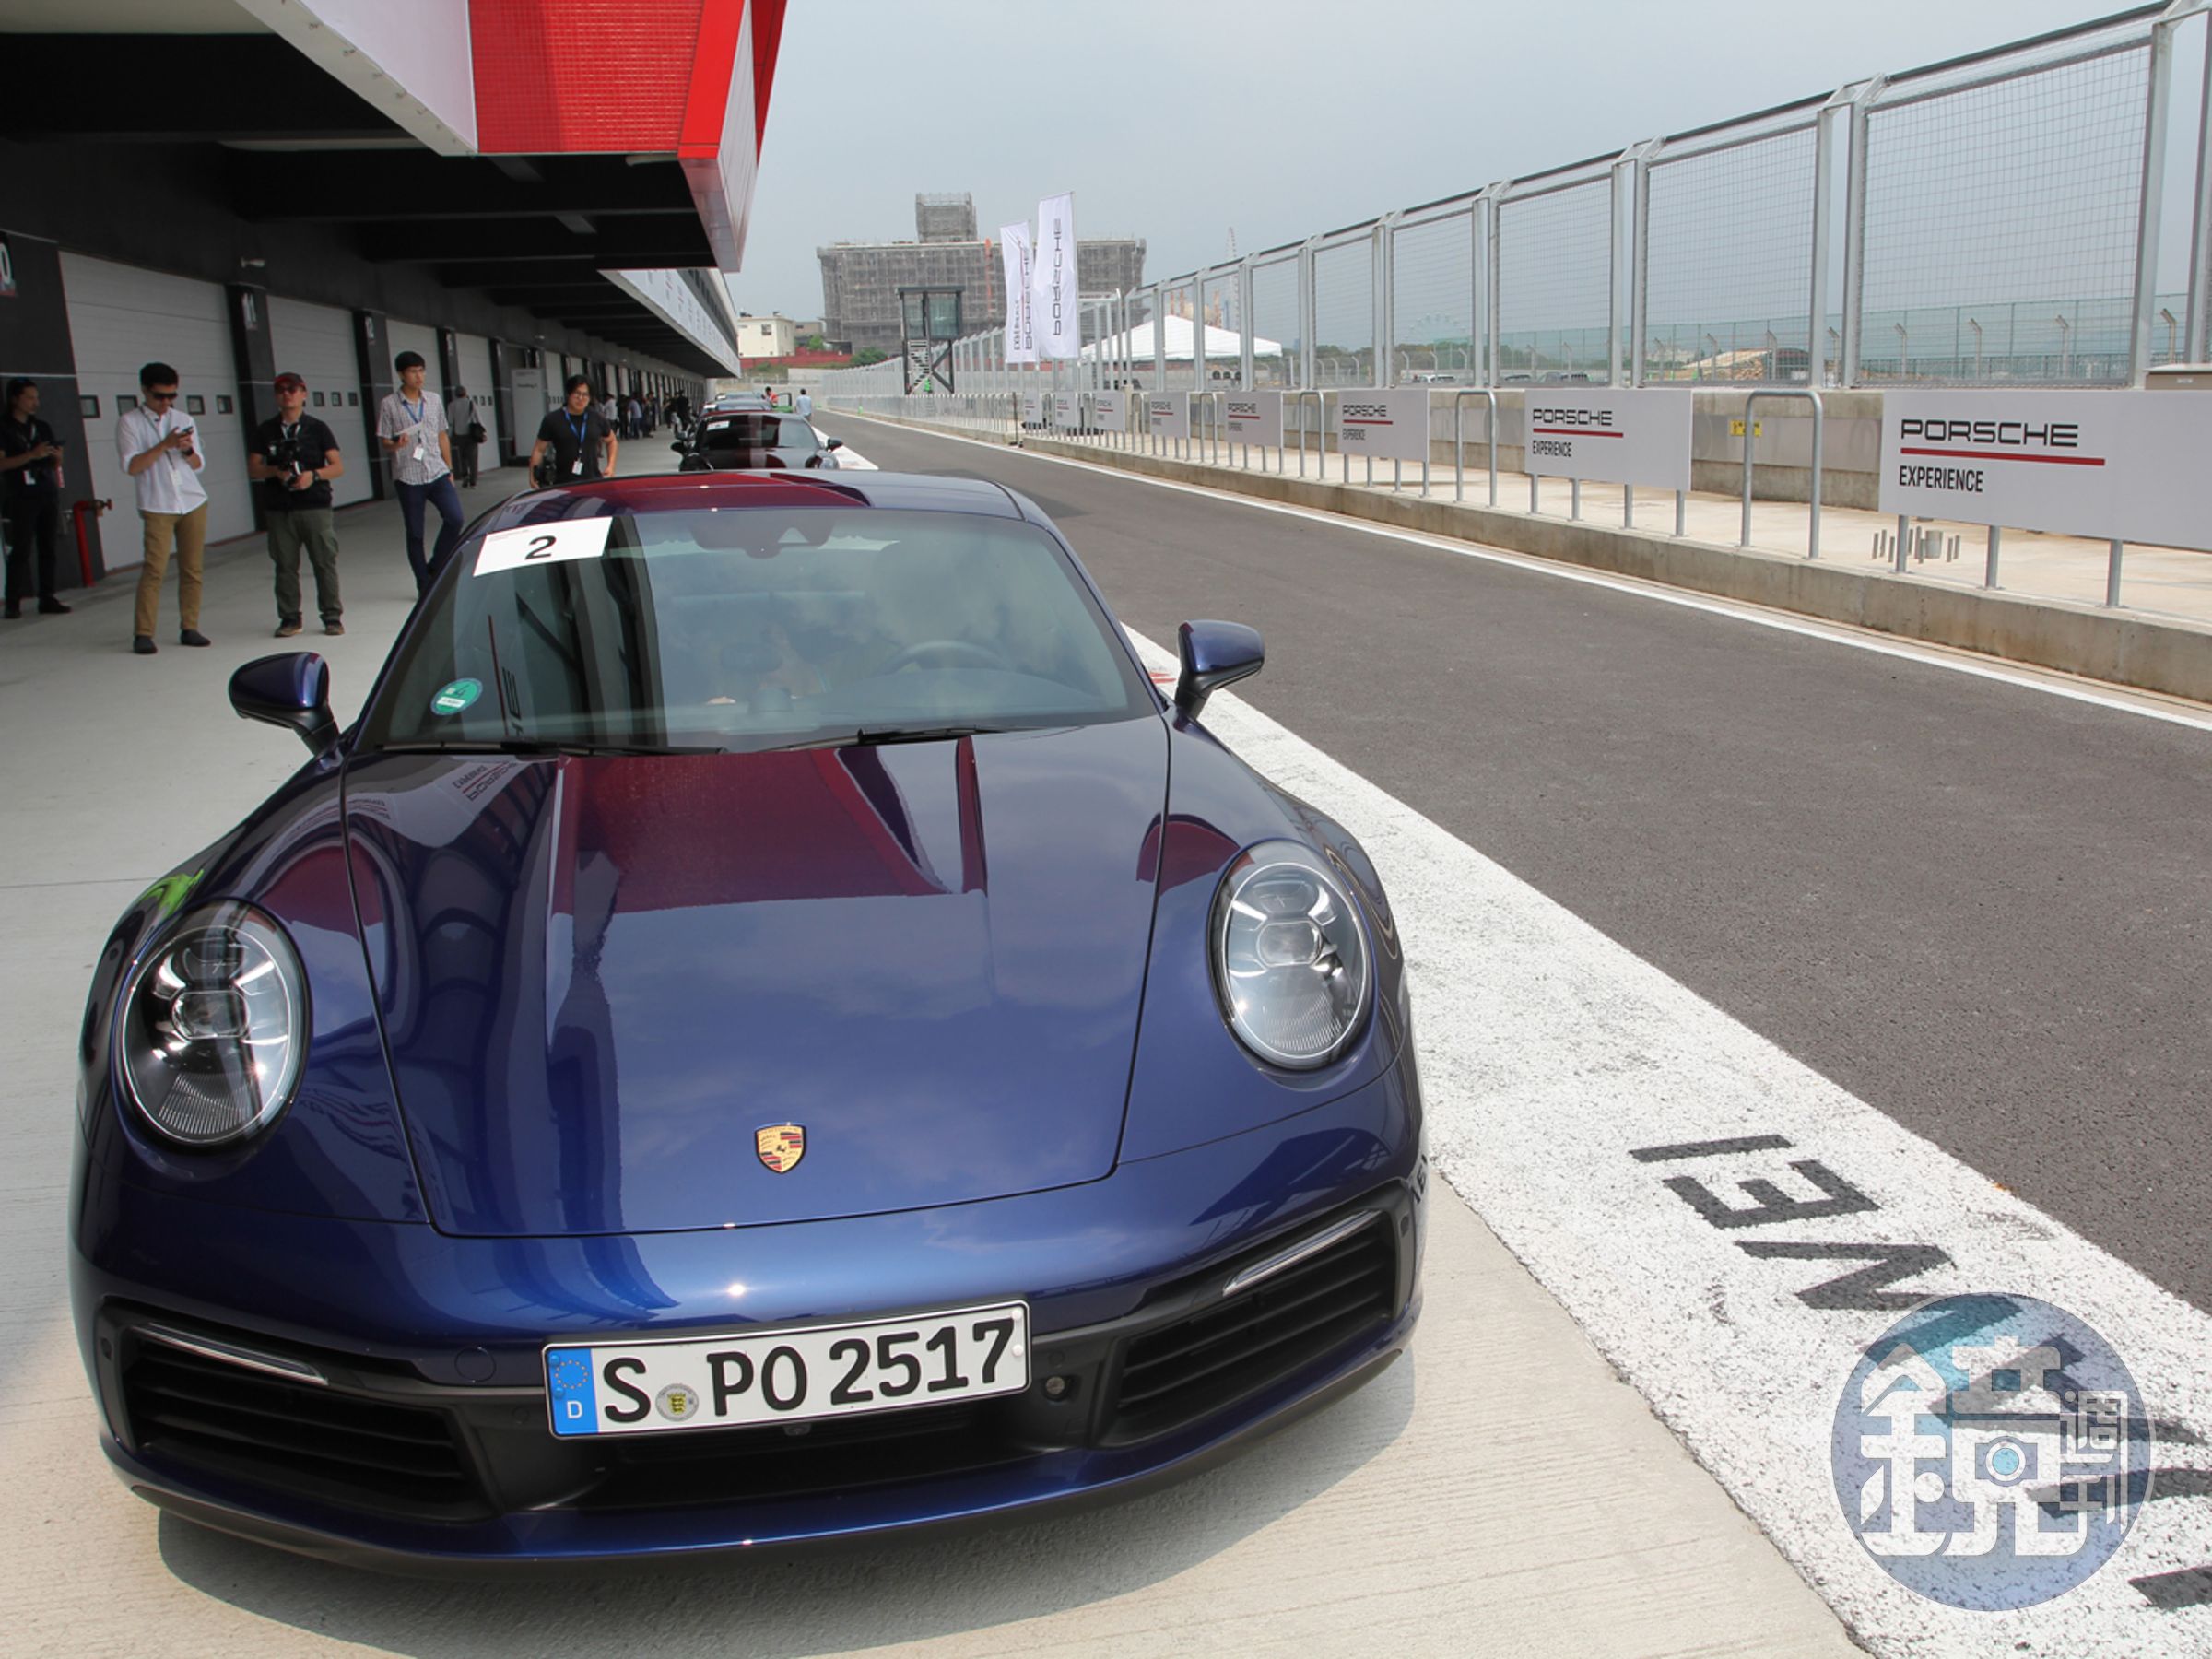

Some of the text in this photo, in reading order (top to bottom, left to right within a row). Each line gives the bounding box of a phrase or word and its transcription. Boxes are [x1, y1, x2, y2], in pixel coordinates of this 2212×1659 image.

[1343, 404, 1387, 418] PORSCHE
[1533, 408, 1612, 427] PORSCHE
[1900, 418, 2079, 448] PORSCHE
[1532, 440, 1572, 458] EXPERIENCE
[1899, 465, 1983, 493] EXPERIENCE
[525, 535, 557, 560] 2
[603, 1357, 651, 1423] S
[706, 1346, 808, 1417] PO
[829, 1317, 1016, 1406] 2517
[567, 1401, 582, 1419] D
